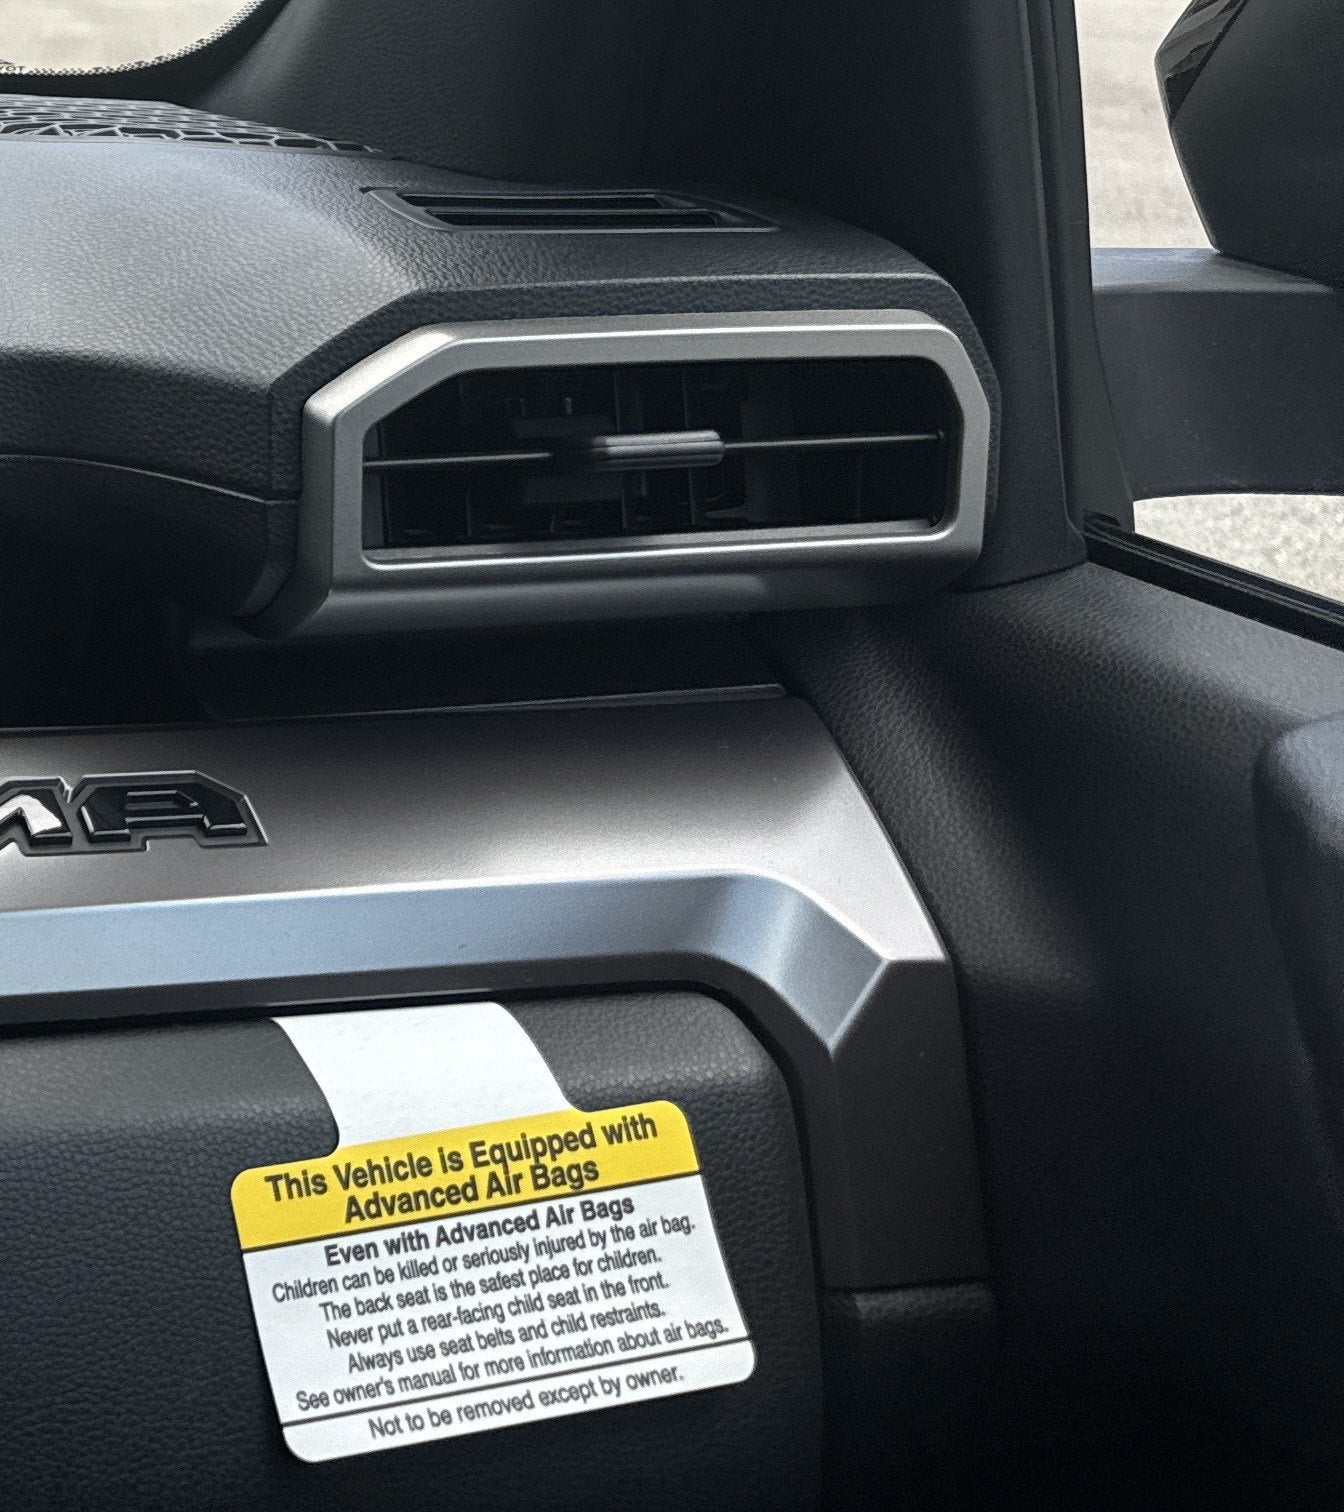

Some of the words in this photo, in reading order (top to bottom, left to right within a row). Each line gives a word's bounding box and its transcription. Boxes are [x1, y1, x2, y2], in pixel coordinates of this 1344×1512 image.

[264, 1169, 328, 1202] This
[332, 1153, 432, 1191] Vehicle
[470, 1121, 597, 1177] Equipped
[601, 1113, 658, 1145] with
[345, 1175, 479, 1223] Advanced
[486, 1168, 523, 1199] Air
[530, 1159, 600, 1192] Bags
[272, 1277, 338, 1303] Children
[342, 1273, 371, 1290] can
[374, 1266, 394, 1285] be
[397, 1255, 438, 1280] killed
[442, 1256, 458, 1272] or
[463, 1241, 530, 1270] seriously
[534, 1230, 586, 1260] injured
[588, 1228, 607, 1250] by
[610, 1225, 635, 1244] the
[639, 1220, 657, 1237] air
[661, 1215, 695, 1234] bag.
[324, 1242, 379, 1266] Even
[384, 1228, 430, 1256] with
[435, 1211, 540, 1248] Advanced
[546, 1203, 575, 1228] Air
[580, 1196, 634, 1222] Bags
[319, 1301, 351, 1322] The
[354, 1292, 394, 1316] back
[396, 1286, 431, 1309] seat
[433, 1283, 447, 1301] is
[450, 1278, 476, 1298] the
[479, 1271, 524, 1294] safest
[528, 1263, 570, 1288] place
[573, 1258, 593, 1277] for
[597, 1247, 661, 1274] children.
[326, 1326, 373, 1349] Never
[378, 1319, 404, 1345] put
[407, 1318, 419, 1334] a
[422, 1303, 505, 1336] rear-facing
[508, 1292, 544, 1316] child
[547, 1285, 581, 1308] seat
[583, 1283, 598, 1301] in
[601, 1278, 627, 1298] the
[628, 1270, 669, 1293] front.
[296, 1389, 330, 1412] See
[333, 1377, 396, 1406] owner's
[399, 1364, 458, 1395] manual
[458, 1361, 481, 1380] for
[484, 1353, 526, 1377] more
[529, 1333, 615, 1369] information
[619, 1325, 661, 1353] about
[663, 1322, 683, 1341] air
[687, 1317, 729, 1339] bags.
[348, 1351, 404, 1374] Always
[406, 1343, 436, 1362] use
[439, 1333, 475, 1357] seat
[477, 1326, 516, 1349] belts
[518, 1322, 548, 1342] and
[550, 1313, 588, 1337] child
[590, 1301, 665, 1329] restraints.
[368, 1415, 403, 1439] Not
[405, 1413, 426, 1432] to
[428, 1407, 453, 1427] be
[456, 1393, 534, 1423] removed
[538, 1378, 599, 1410] except
[601, 1374, 623, 1399] by
[625, 1365, 684, 1392] owner.
